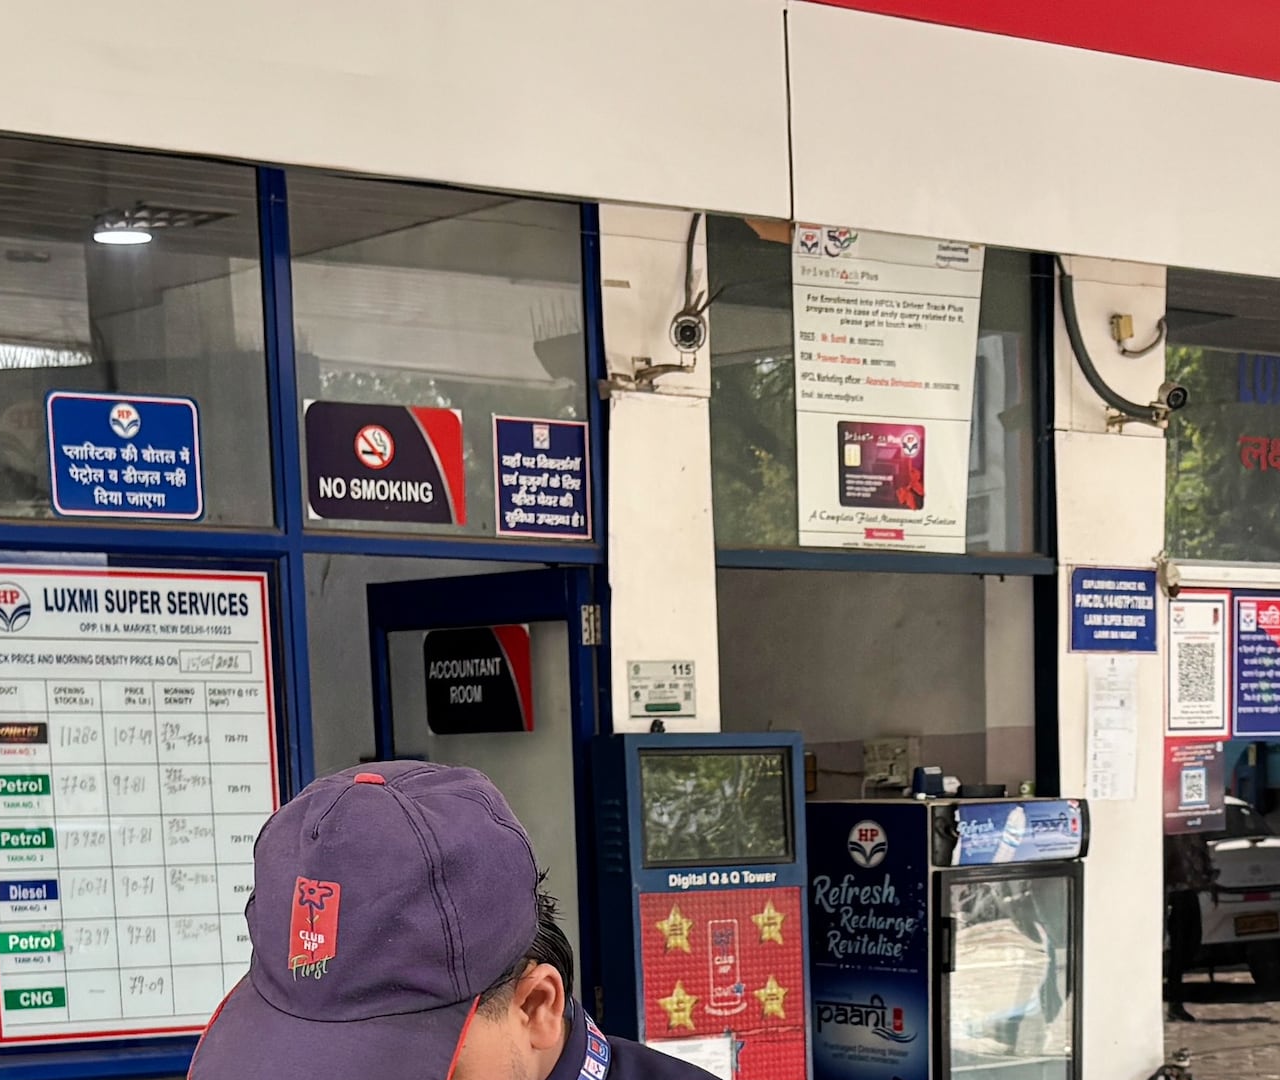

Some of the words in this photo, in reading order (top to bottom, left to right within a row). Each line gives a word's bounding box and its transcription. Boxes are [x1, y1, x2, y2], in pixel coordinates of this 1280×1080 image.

[121, 443, 138, 463] की
[141, 445, 176, 464] बोतल
[179, 446, 190, 465] में
[69, 463, 105, 486] पेट्रोल
[108, 469, 119, 483] व
[93, 485, 123, 505] दिया
[126, 492, 166, 508] जाएगा
[319, 477, 347, 499] NO
[350, 478, 434, 503] SMOKING
[43, 588, 99, 613] LUXMI
[104, 589, 161, 615] SUPER
[167, 591, 249, 617] SERVICES
[429, 657, 502, 680] ACCOUNTANT
[671, 663, 692, 675] 115
[449, 685, 483, 704] ROOM
[0, 831, 47, 846] Petrol
[857, 828, 879, 842] HP
[668, 873, 707, 890] Digital
[709, 872, 720, 886] Q
[721, 873, 729, 884] &
[730, 871, 740, 885] Q
[743, 871, 777, 884] Tower
[8, 884, 47, 900] Diesel
[8, 933, 56, 949] Petrol
[299, 930, 325, 944] CLUB
[303, 940, 318, 951] HP
[291, 954, 333, 982] First
[19, 991, 53, 1006] CNG
